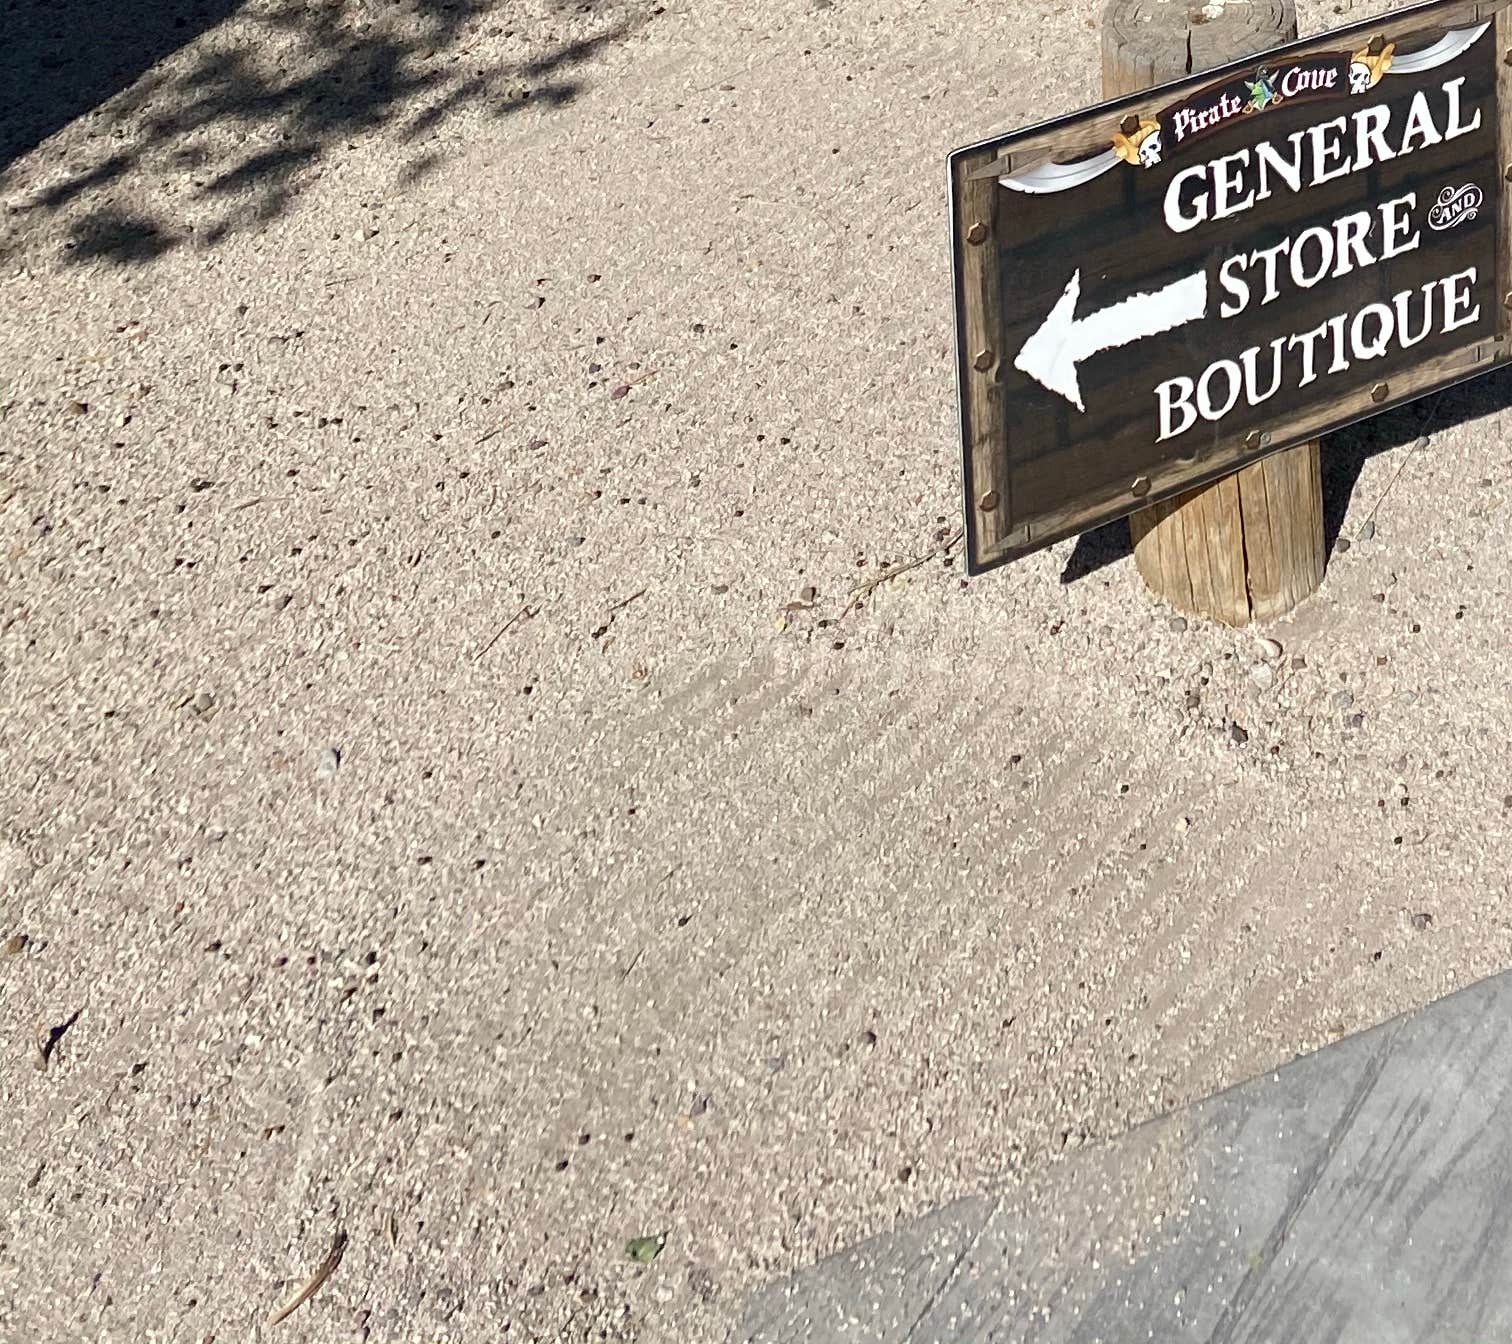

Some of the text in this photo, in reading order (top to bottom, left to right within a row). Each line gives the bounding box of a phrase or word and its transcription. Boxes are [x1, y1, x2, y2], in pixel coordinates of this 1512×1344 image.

[1163, 76, 1482, 234] GENERAL
[1172, 66, 1339, 143] Pirate Cove
[1218, 192, 1476, 319] STORE AND
[1154, 268, 1480, 443] BOUTIQUE
